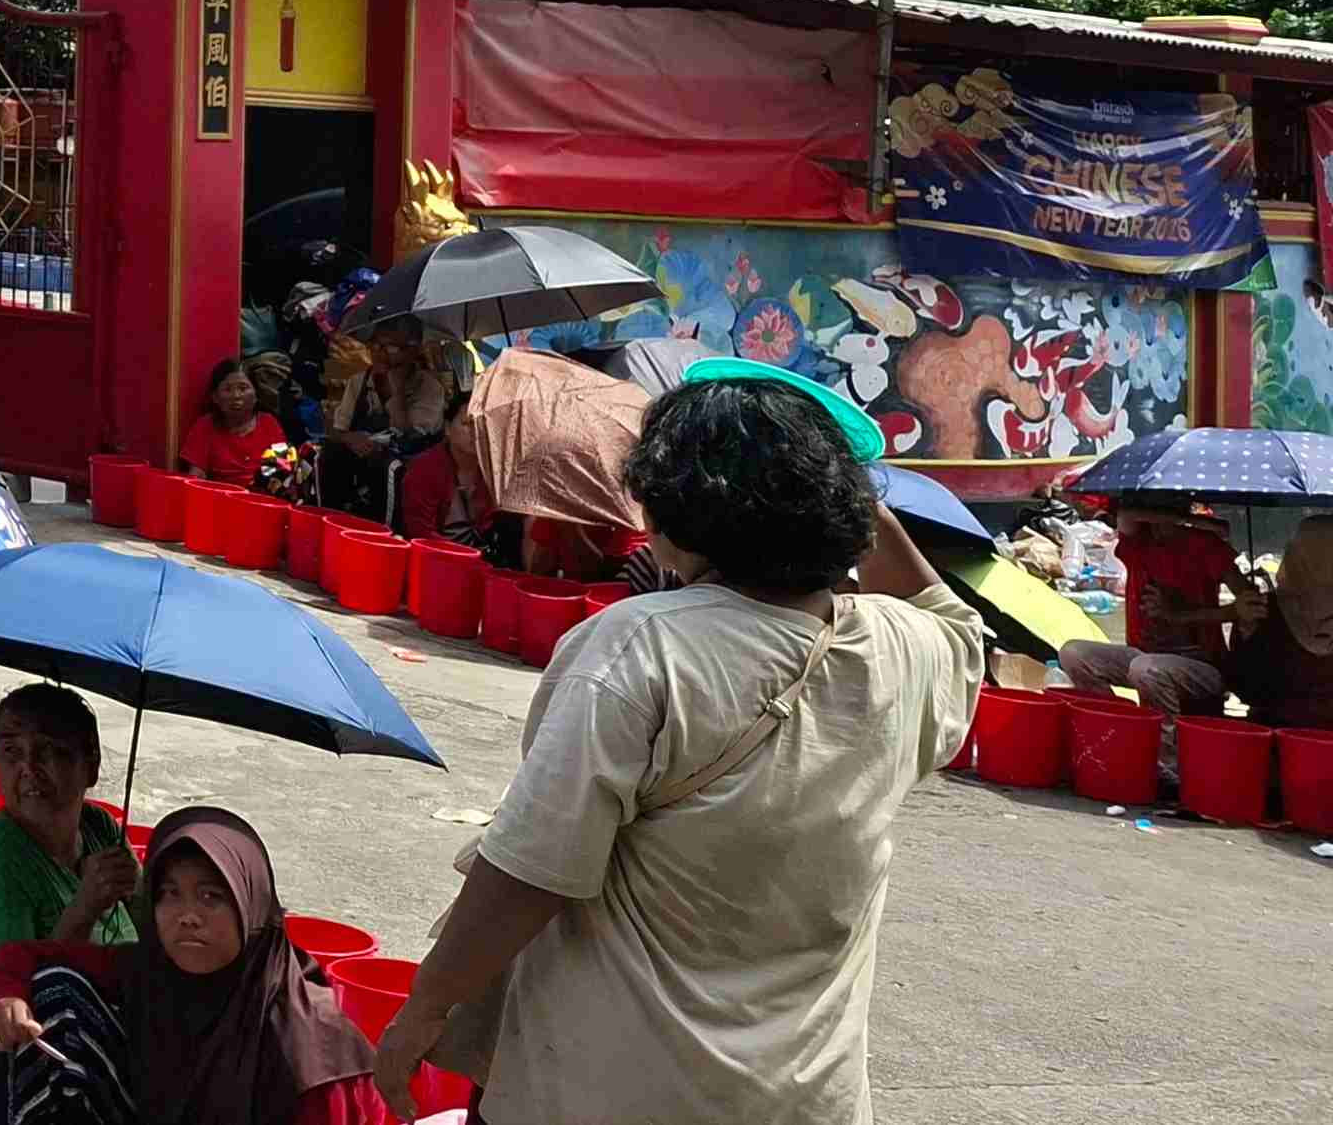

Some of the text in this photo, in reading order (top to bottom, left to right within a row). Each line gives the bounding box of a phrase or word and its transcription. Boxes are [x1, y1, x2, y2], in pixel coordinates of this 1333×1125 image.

[1023, 154, 1191, 209] CHINESE
[1033, 204, 1086, 236] NEW
[1092, 214, 1144, 241] YEAR
